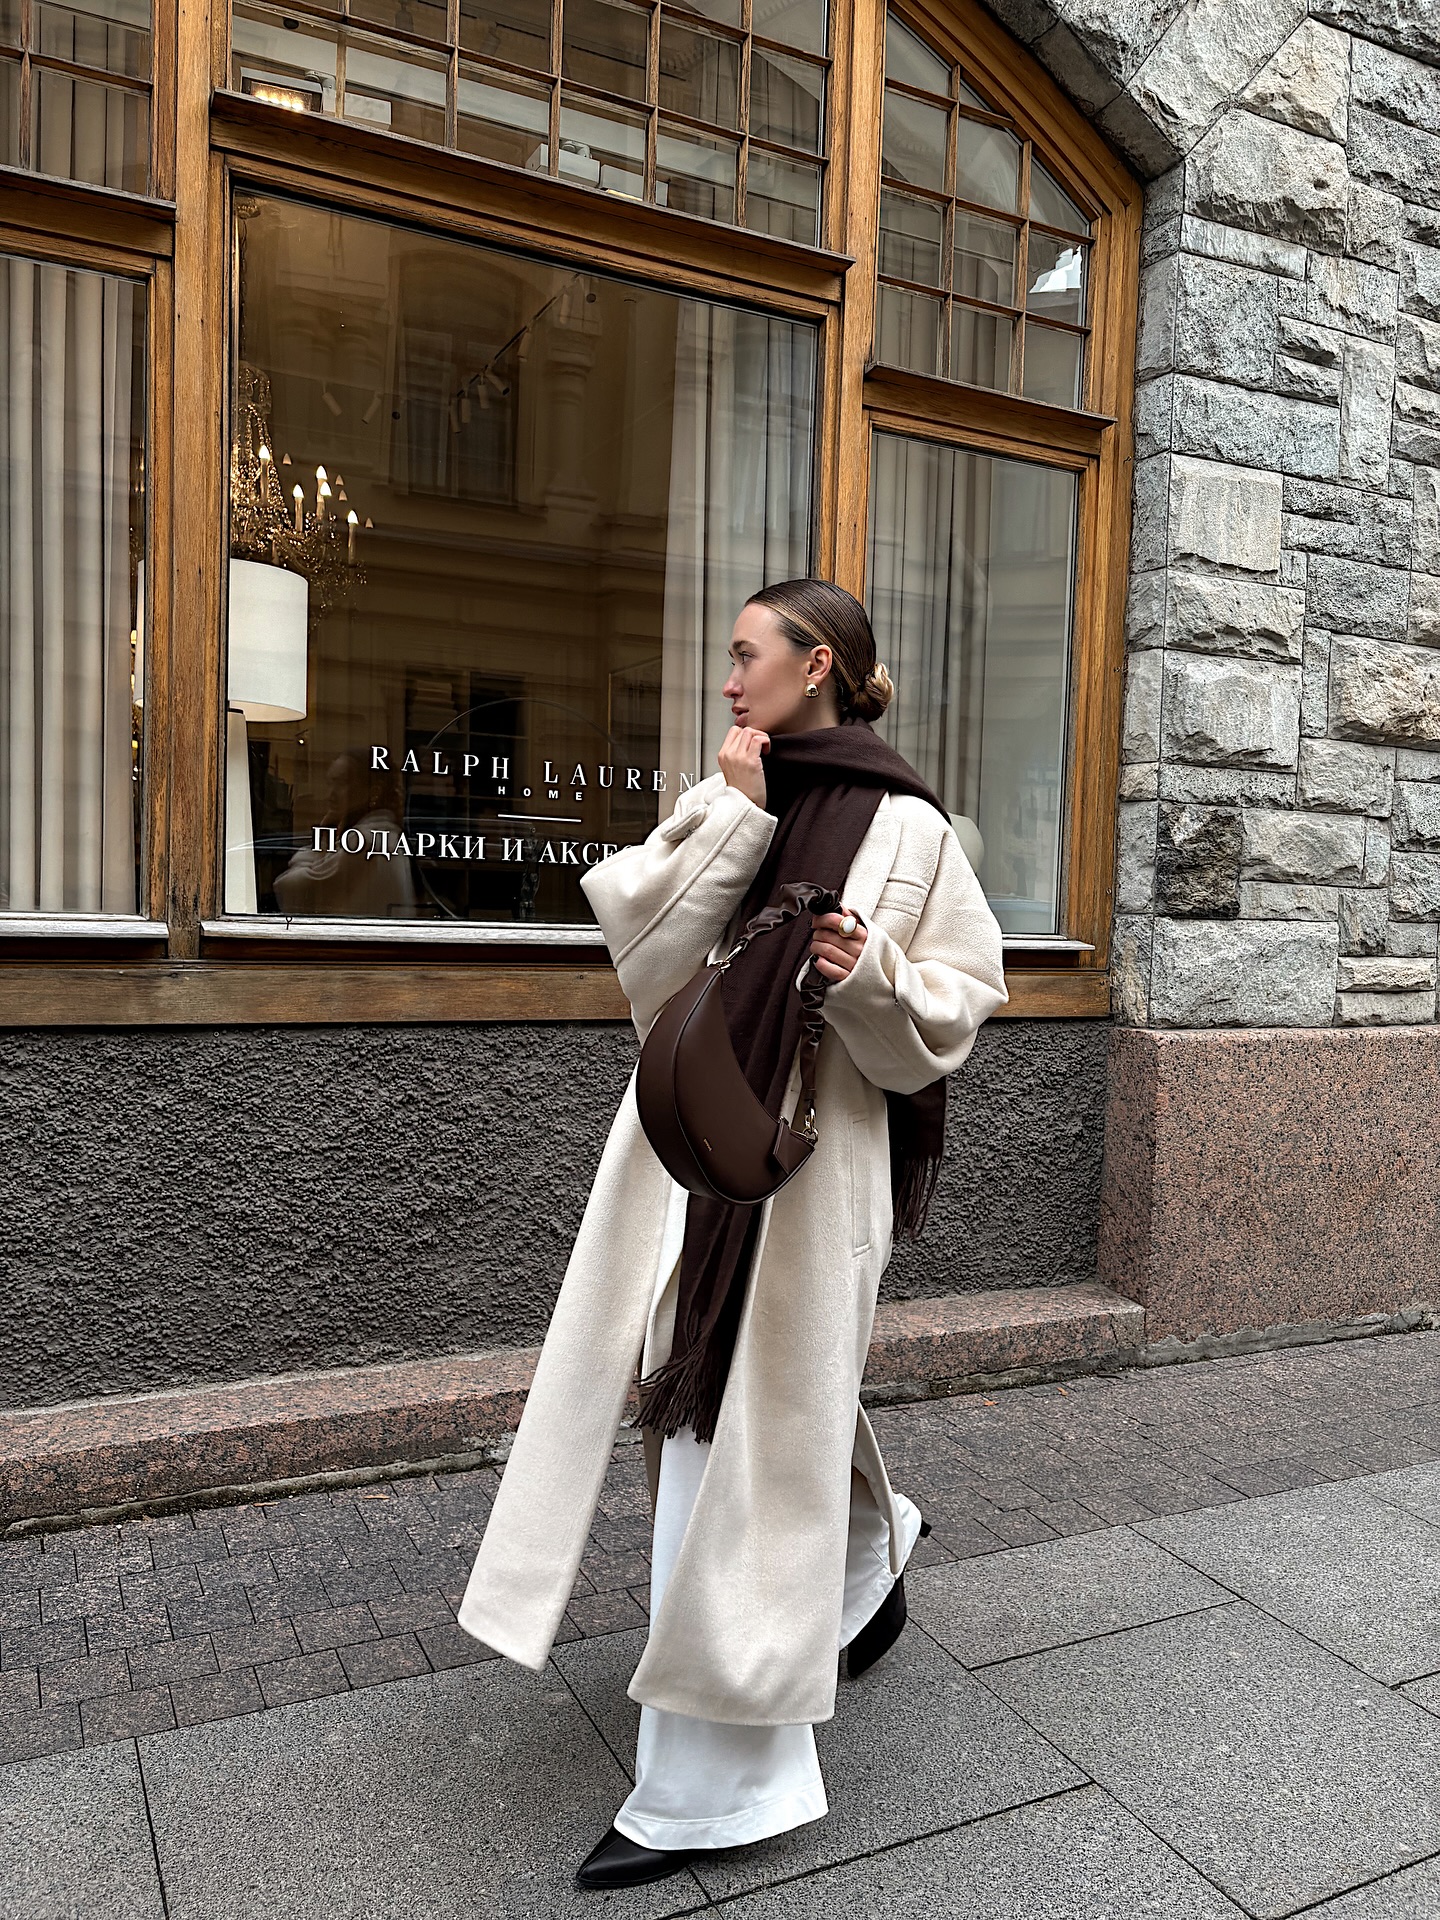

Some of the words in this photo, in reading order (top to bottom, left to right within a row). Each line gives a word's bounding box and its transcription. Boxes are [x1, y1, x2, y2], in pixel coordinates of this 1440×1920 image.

[370, 745, 510, 780] RALPH
[543, 760, 695, 793] LAUREN
[497, 785, 583, 801] HOME
[311, 826, 487, 862] ПОДАРКИ
[501, 837, 525, 862] И
[538, 840, 632, 866] АКСЕ
